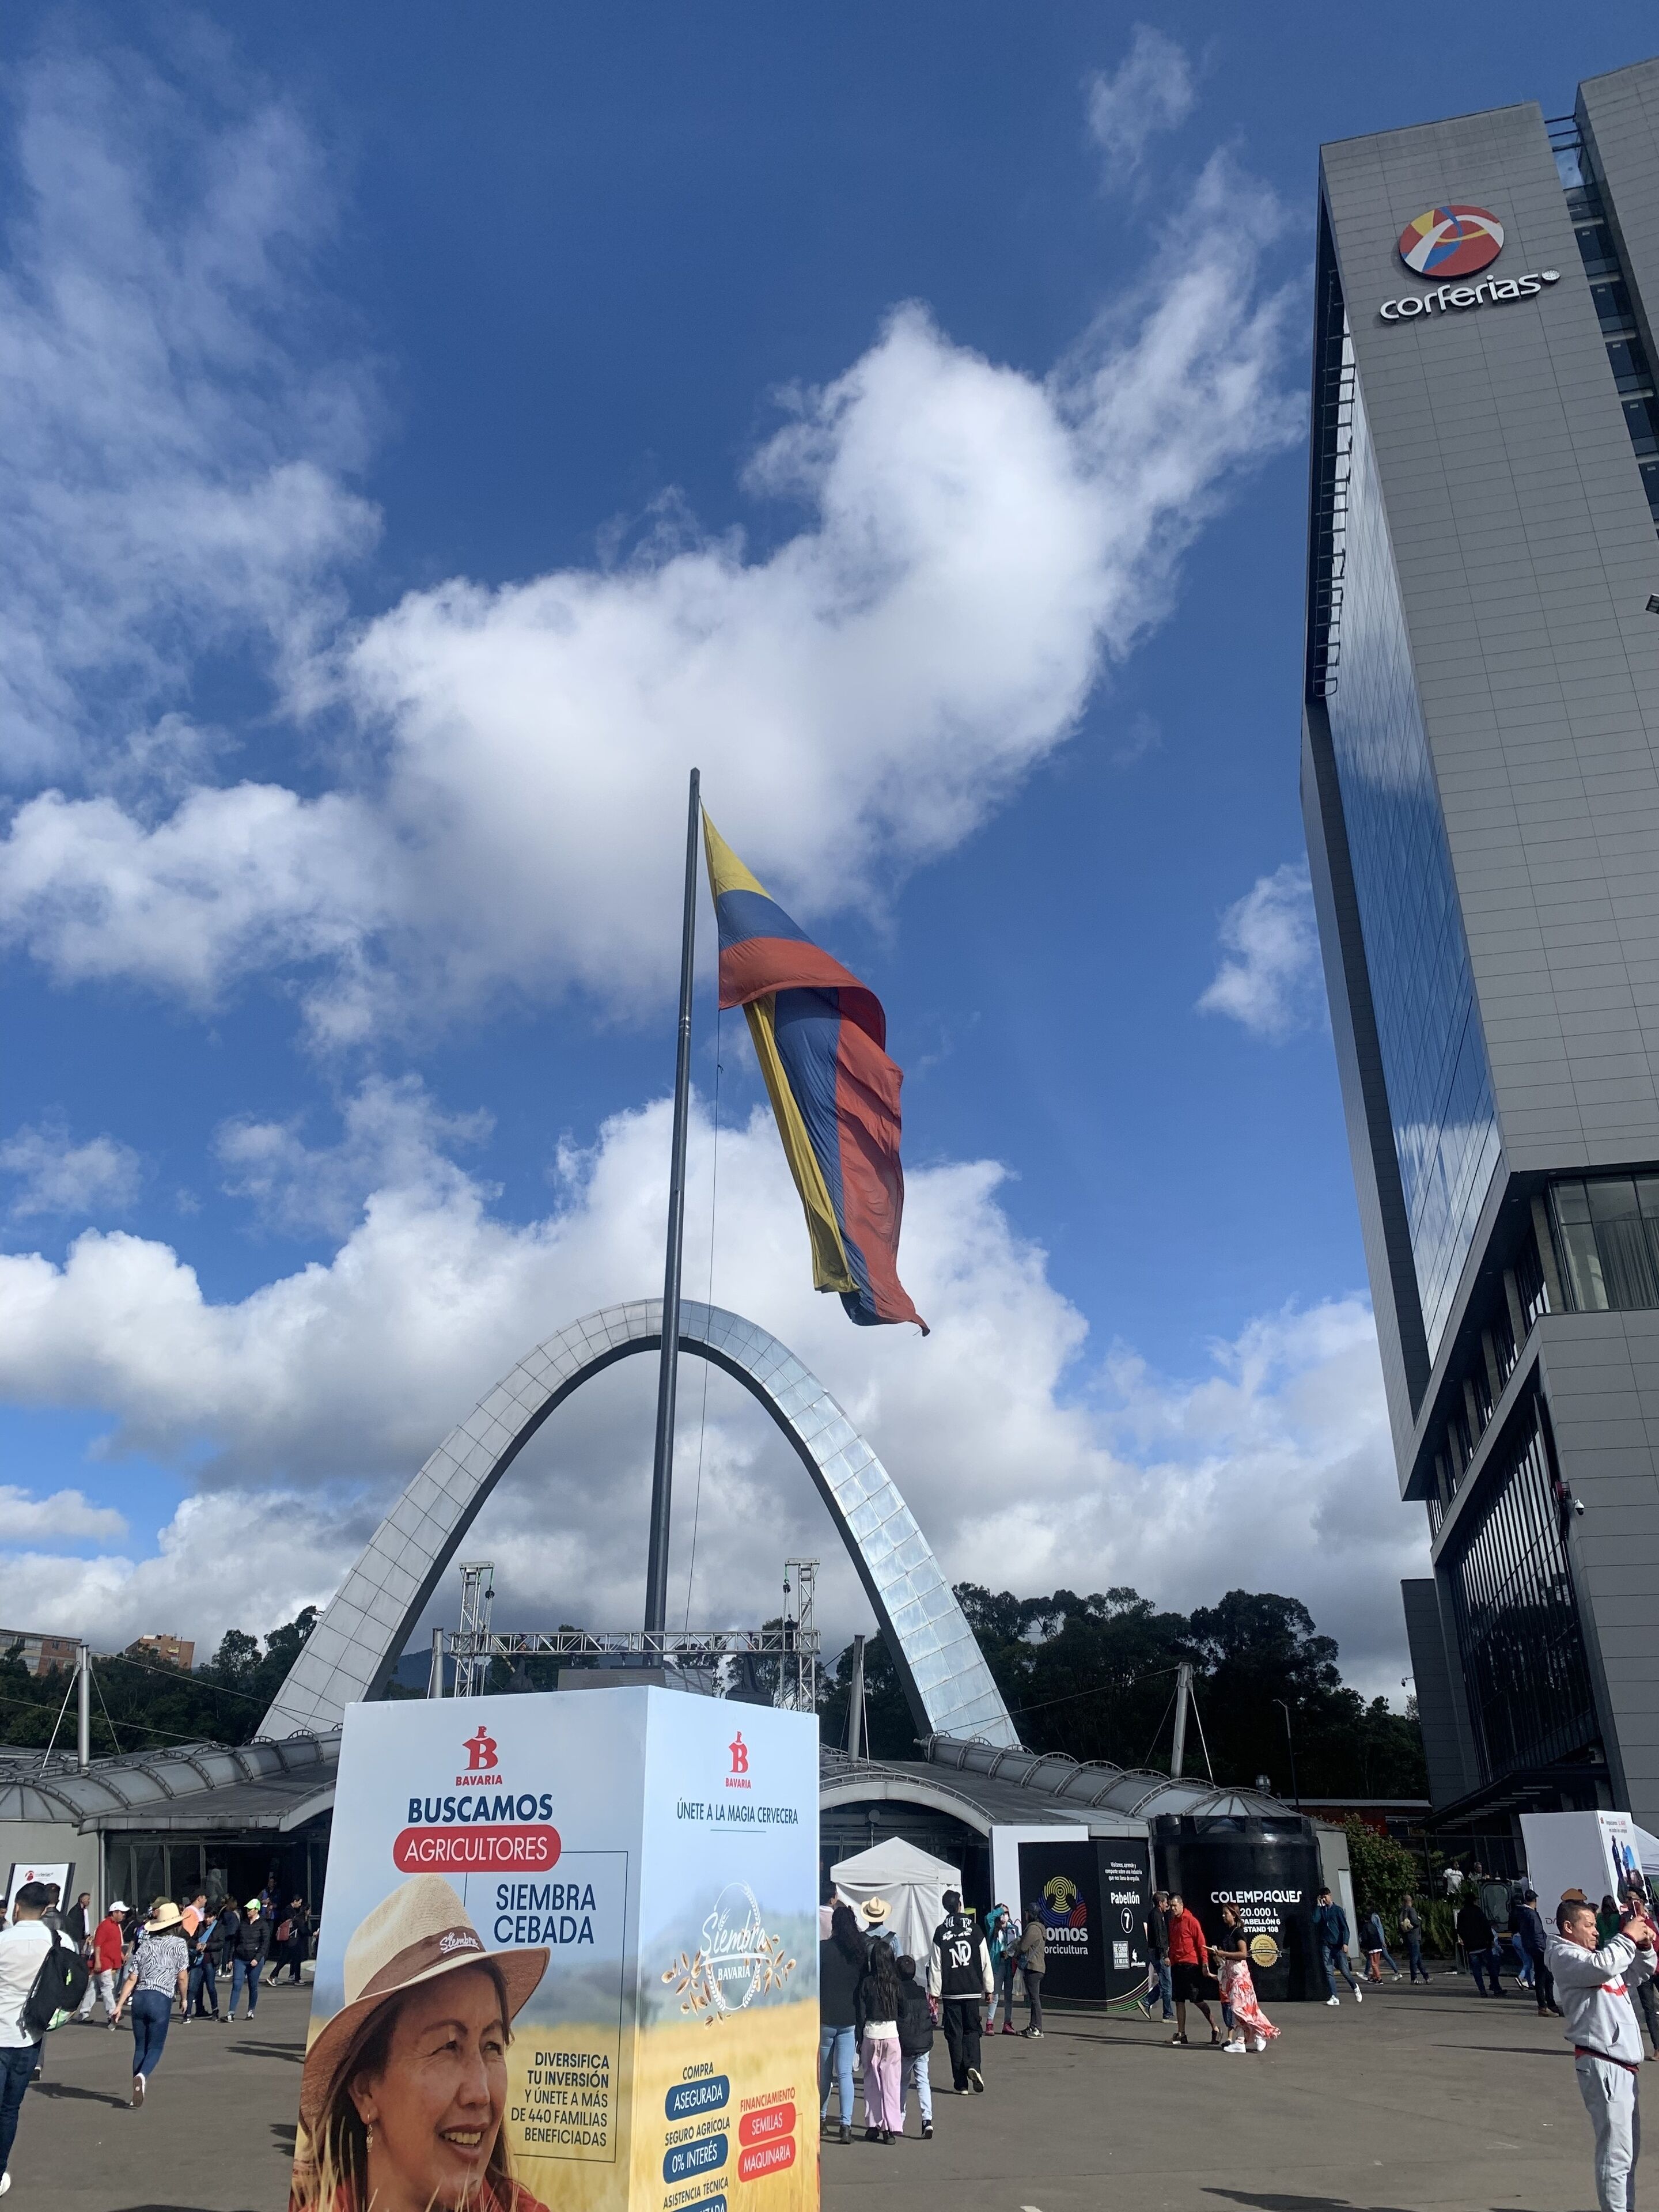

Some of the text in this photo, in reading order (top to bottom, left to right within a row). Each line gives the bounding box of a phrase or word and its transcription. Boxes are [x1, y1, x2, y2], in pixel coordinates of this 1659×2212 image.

[1380, 274, 1541, 319] corferias
[456, 1775, 502, 1786] BAVARIA
[725, 1778, 751, 1789] BAVARIA
[408, 1794, 553, 1823] BUSCAMOS
[677, 1797, 798, 1824] ÚNETE A LA MAGIA CERVECERA
[403, 1836, 547, 1862] AGRICULTORES
[496, 1884, 596, 1911] SIEMBRA
[1111, 1891, 1140, 1904] Pabellón
[1211, 1890, 1302, 1903] COLEMPAQUES
[1124, 1912, 1130, 1929] 7
[1240, 1907, 1278, 1916] 20.000 L
[494, 1915, 594, 1944] CEBADA
[700, 1910, 767, 1956] Siembra
[1046, 1927, 1088, 1941] omos
[440, 1932, 479, 1951] Siembra
[1044, 1944, 1088, 1955] orcicultura
[718, 1965, 751, 1980] BAVARIA
[535, 2052, 609, 2069] DIVERSIFICA
[527, 2070, 609, 2088] TU INVERSIÓN
[683, 2062, 714, 2080] COMPRA
[525, 2087, 608, 2108] Y ÚNETE A MÁS
[673, 2084, 722, 2111] ASEGURADA
[740, 2087, 795, 2112] FINANCIAMIENTO
[511, 2107, 607, 2127] DE 440 FAMILIAS
[751, 2112, 783, 2136] SEMILLAS
[525, 2127, 607, 2147] BENEFICIADAS
[665, 2116, 730, 2146] SEGURO AGRÍCOLA
[672, 2140, 717, 2173] 0% INTERÉS
[743, 2144, 791, 2173] MAQUINARIA
[663, 2186, 701, 2210] ASISTENCIA
[703, 2176, 729, 2195] TÉCNICA
